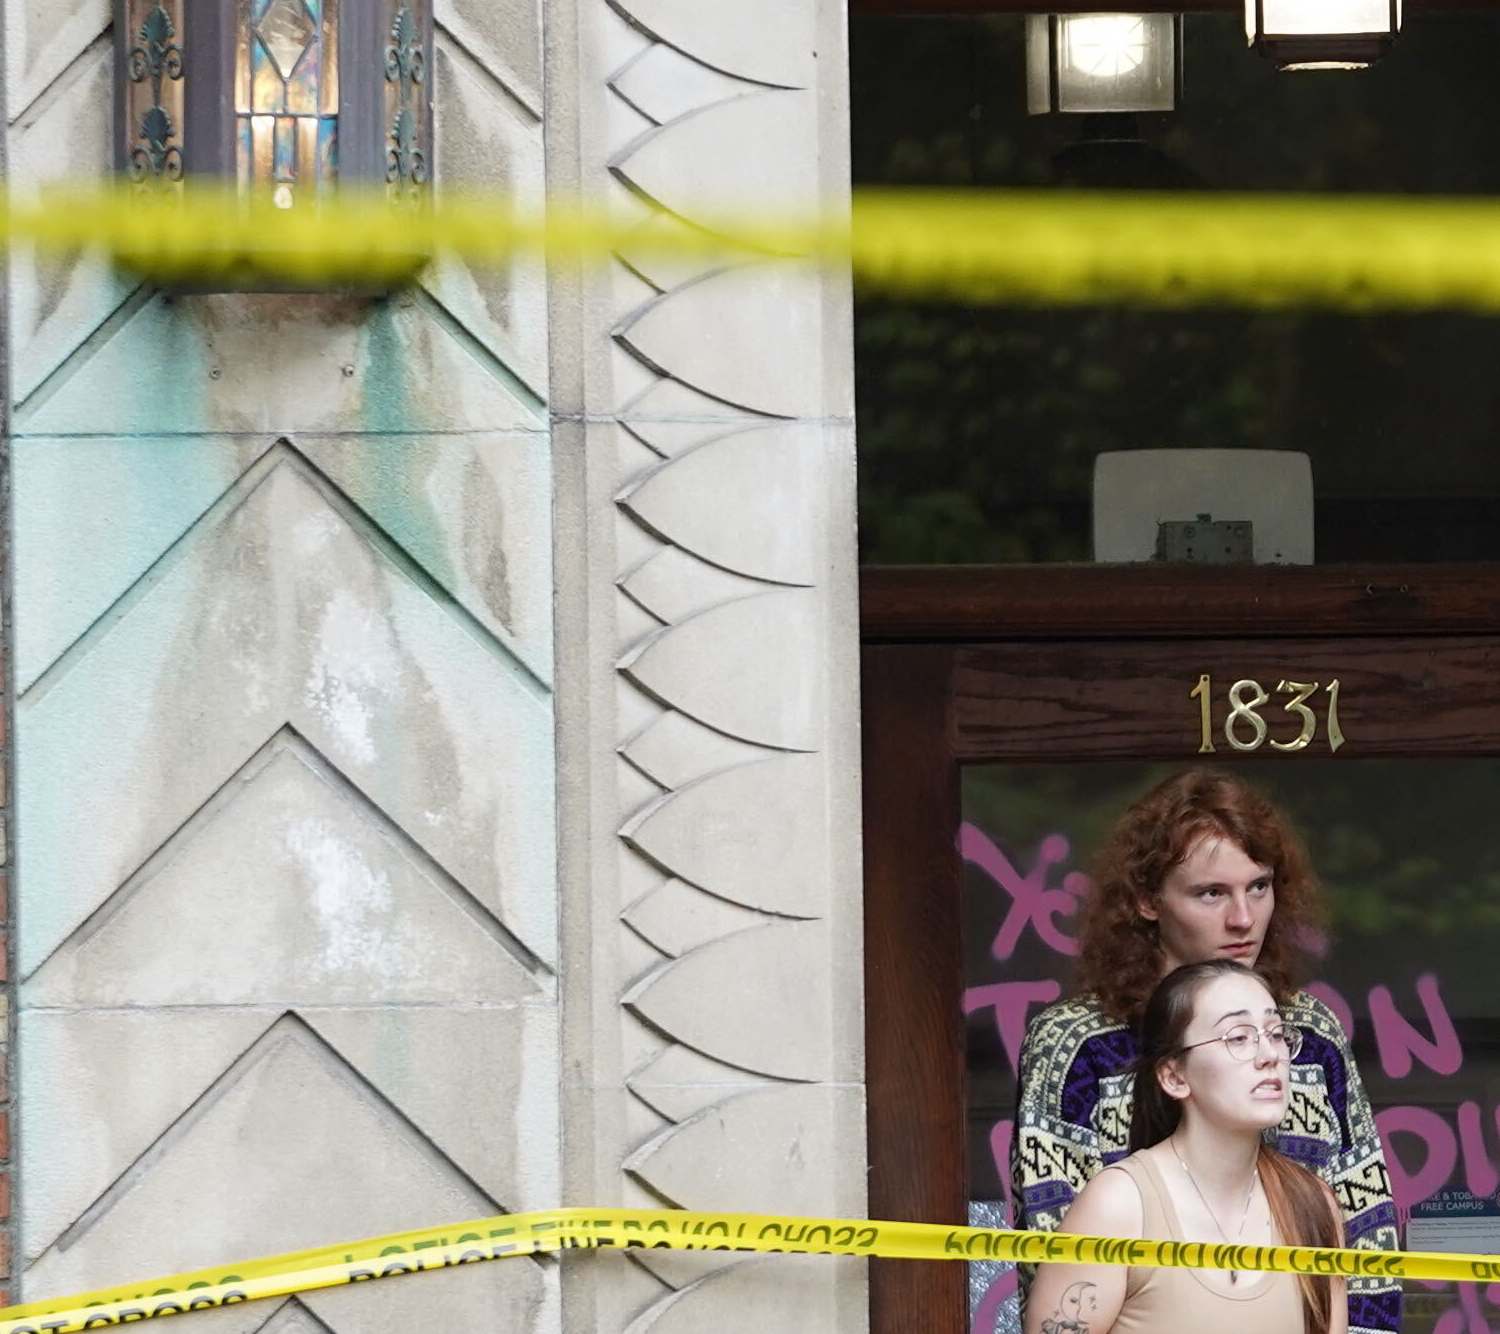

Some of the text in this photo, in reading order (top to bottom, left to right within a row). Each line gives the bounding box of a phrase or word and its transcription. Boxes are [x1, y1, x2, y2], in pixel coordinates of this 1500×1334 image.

[1189, 674, 1346, 753] 1831
[1420, 1201, 1485, 1211] FREE CAMPUS
